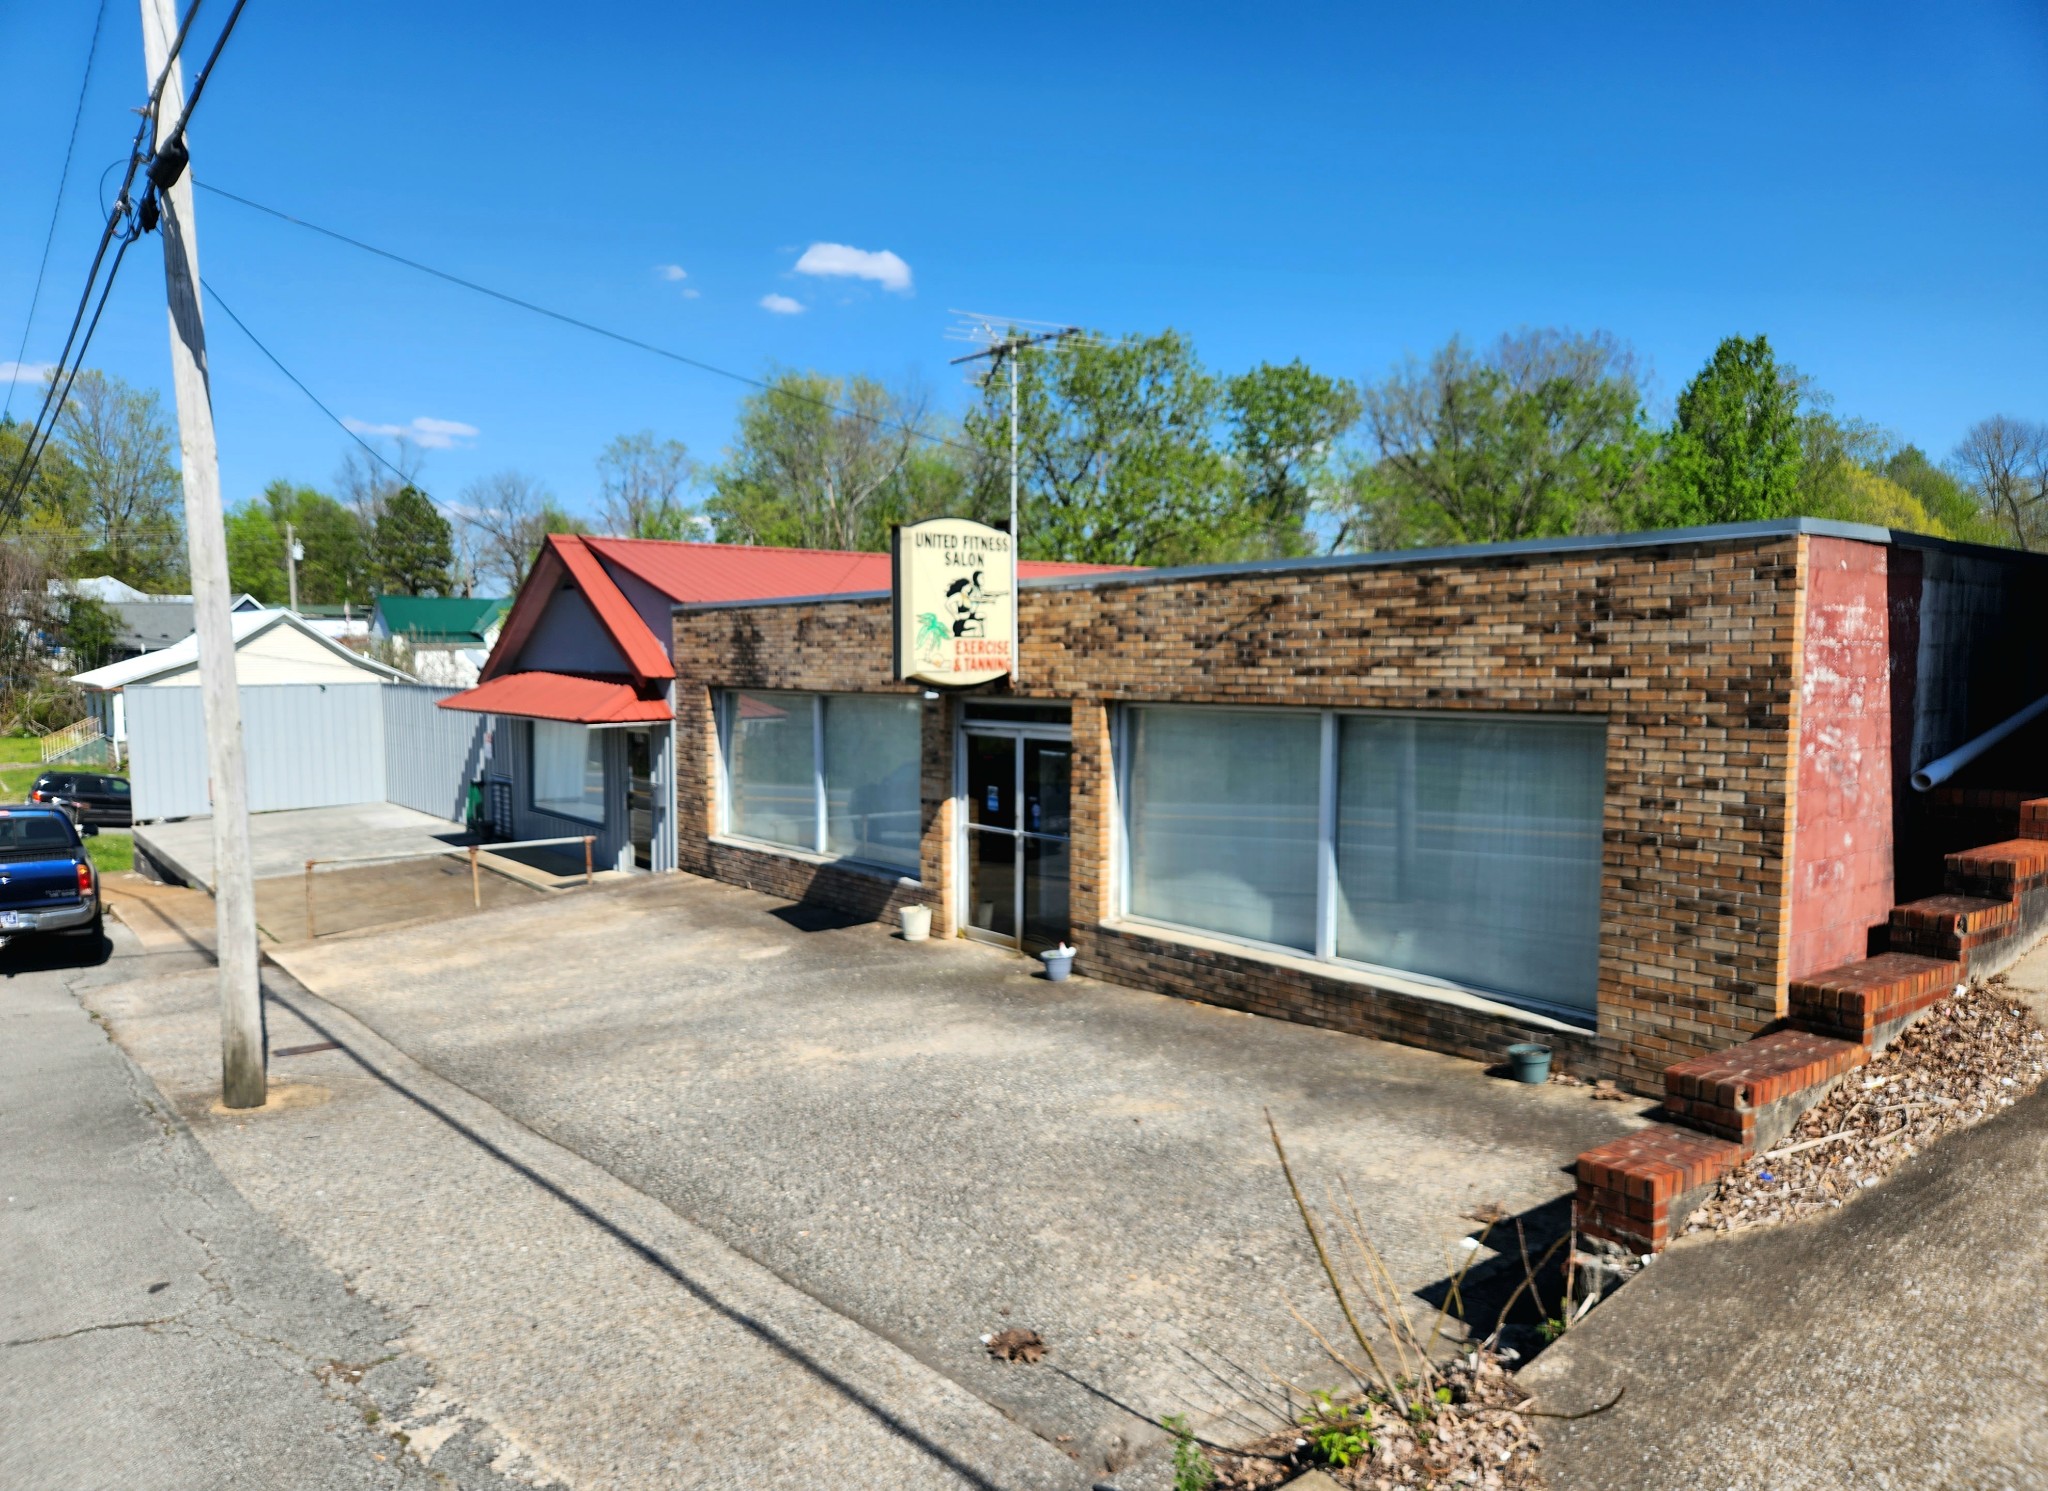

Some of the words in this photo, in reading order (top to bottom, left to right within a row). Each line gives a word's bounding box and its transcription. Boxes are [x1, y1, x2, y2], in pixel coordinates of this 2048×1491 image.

[915, 532, 958, 549] UNITED
[963, 535, 1009, 552] FITNESS
[945, 551, 984, 567] SALON
[955, 640, 1010, 655] EXERCISE
[953, 658, 961, 672] &
[964, 657, 1012, 673] TANNING
